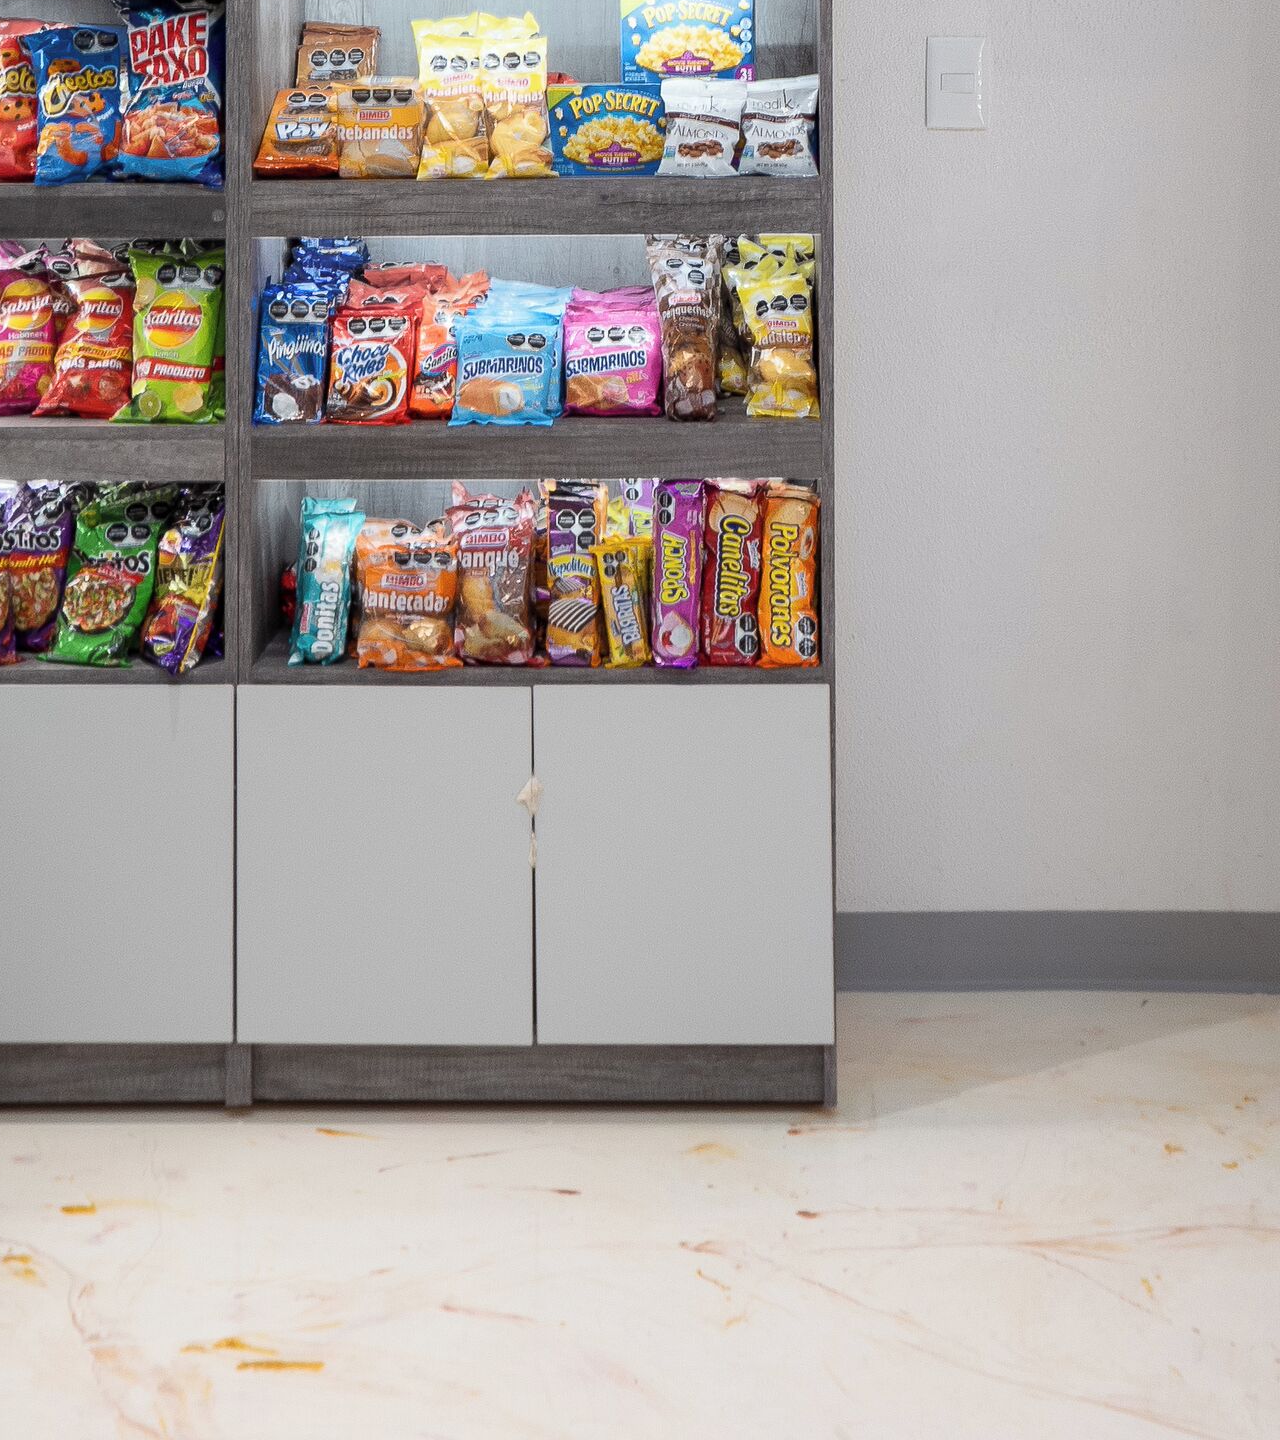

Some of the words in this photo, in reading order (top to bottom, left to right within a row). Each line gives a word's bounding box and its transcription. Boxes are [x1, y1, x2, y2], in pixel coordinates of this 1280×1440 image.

[129, 10, 208, 60] PAKE
[134, 46, 208, 91] TAXO
[739, 67, 747, 81] 3
[43, 65, 116, 118] Cheetos
[426, 85, 483, 98] Madalena
[358, 110, 390, 121] BIMBO
[276, 122, 331, 141] Pay
[337, 125, 414, 142] Rebanadas
[0, 294, 52, 317] Sabrita
[84, 301, 121, 317] ritas
[144, 309, 202, 328] Sabritas
[18, 344, 54, 359] PRODU
[268, 335, 325, 366] Pingüinos
[337, 343, 390, 366] Choco
[153, 364, 207, 379] PRODUCTO
[463, 355, 544, 381] SUBMARINOS
[566, 350, 646, 378] SUBMARINOS
[464, 532, 507, 545] BIMBO
[458, 549, 519, 576] anqué
[715, 513, 753, 622] Canelitas
[385, 573, 425, 586] BIMBO
[770, 522, 801, 650] Polvorones
[363, 590, 450, 612] antecadas
[310, 580, 341, 660] Donitas
